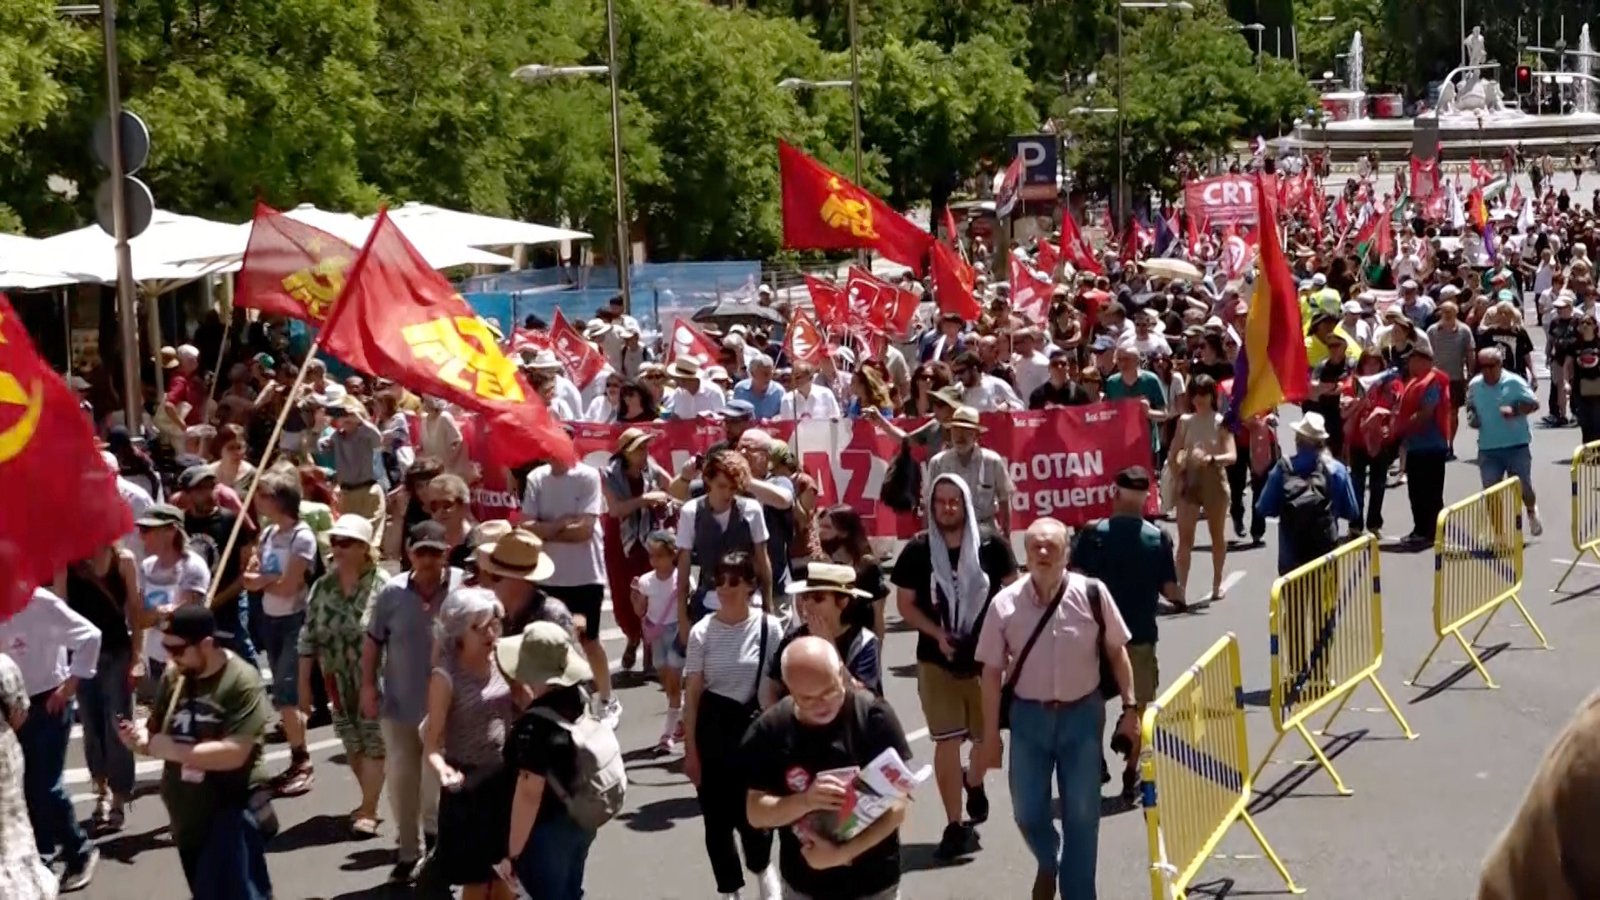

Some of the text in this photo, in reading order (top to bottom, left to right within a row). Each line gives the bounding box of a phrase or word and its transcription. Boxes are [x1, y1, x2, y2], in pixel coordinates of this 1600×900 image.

[1017, 142, 1046, 181] P
[1203, 181, 1253, 205] CRT
[1031, 451, 1104, 480] OTAN
